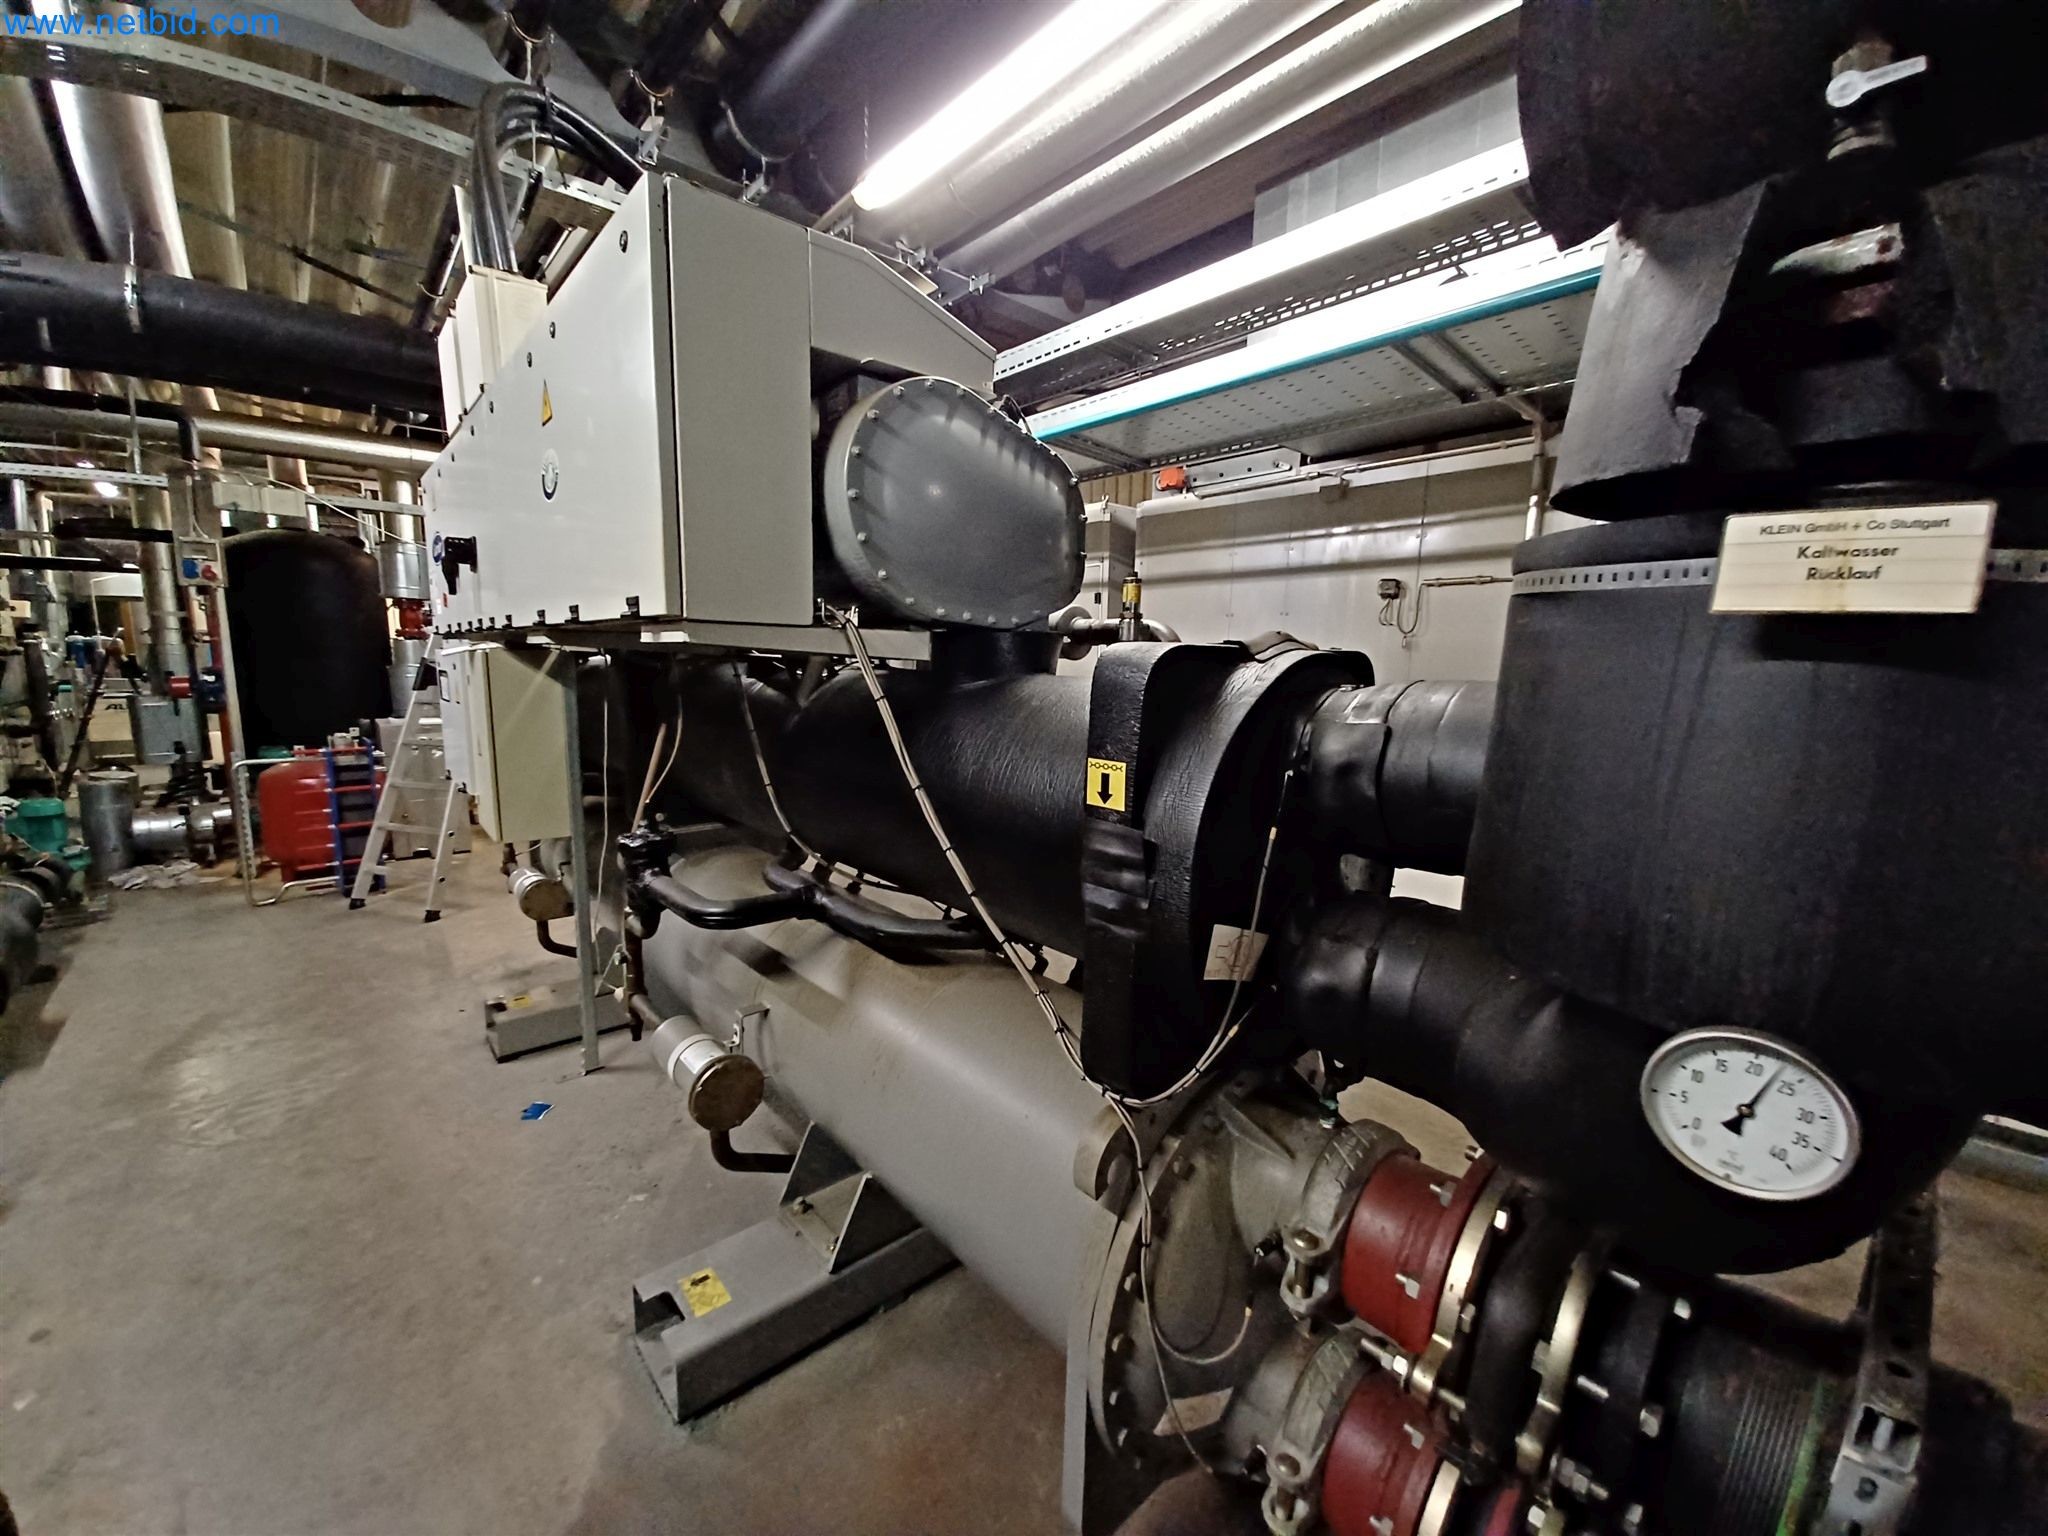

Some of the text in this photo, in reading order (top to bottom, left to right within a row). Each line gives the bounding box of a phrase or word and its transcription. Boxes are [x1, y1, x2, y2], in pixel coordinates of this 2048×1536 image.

[1760, 524, 1801, 536] KLEIN
[1805, 521, 1848, 534] GmbH
[1866, 519, 1886, 530] Co
[1890, 517, 1951, 531] Stuttgart
[1797, 546, 1900, 559] Kaltwasser
[1715, 1058, 1729, 1073] 15
[1744, 1060, 1764, 1077] 20
[1690, 1069, 1704, 1084] 10
[1776, 1079, 1796, 1097] 25
[1680, 1091, 1689, 1104] 5
[1691, 1117, 1701, 1130] 0
[1796, 1107, 1815, 1124] 30
[1791, 1131, 1810, 1148] 35
[1768, 1144, 1789, 1162] 40
